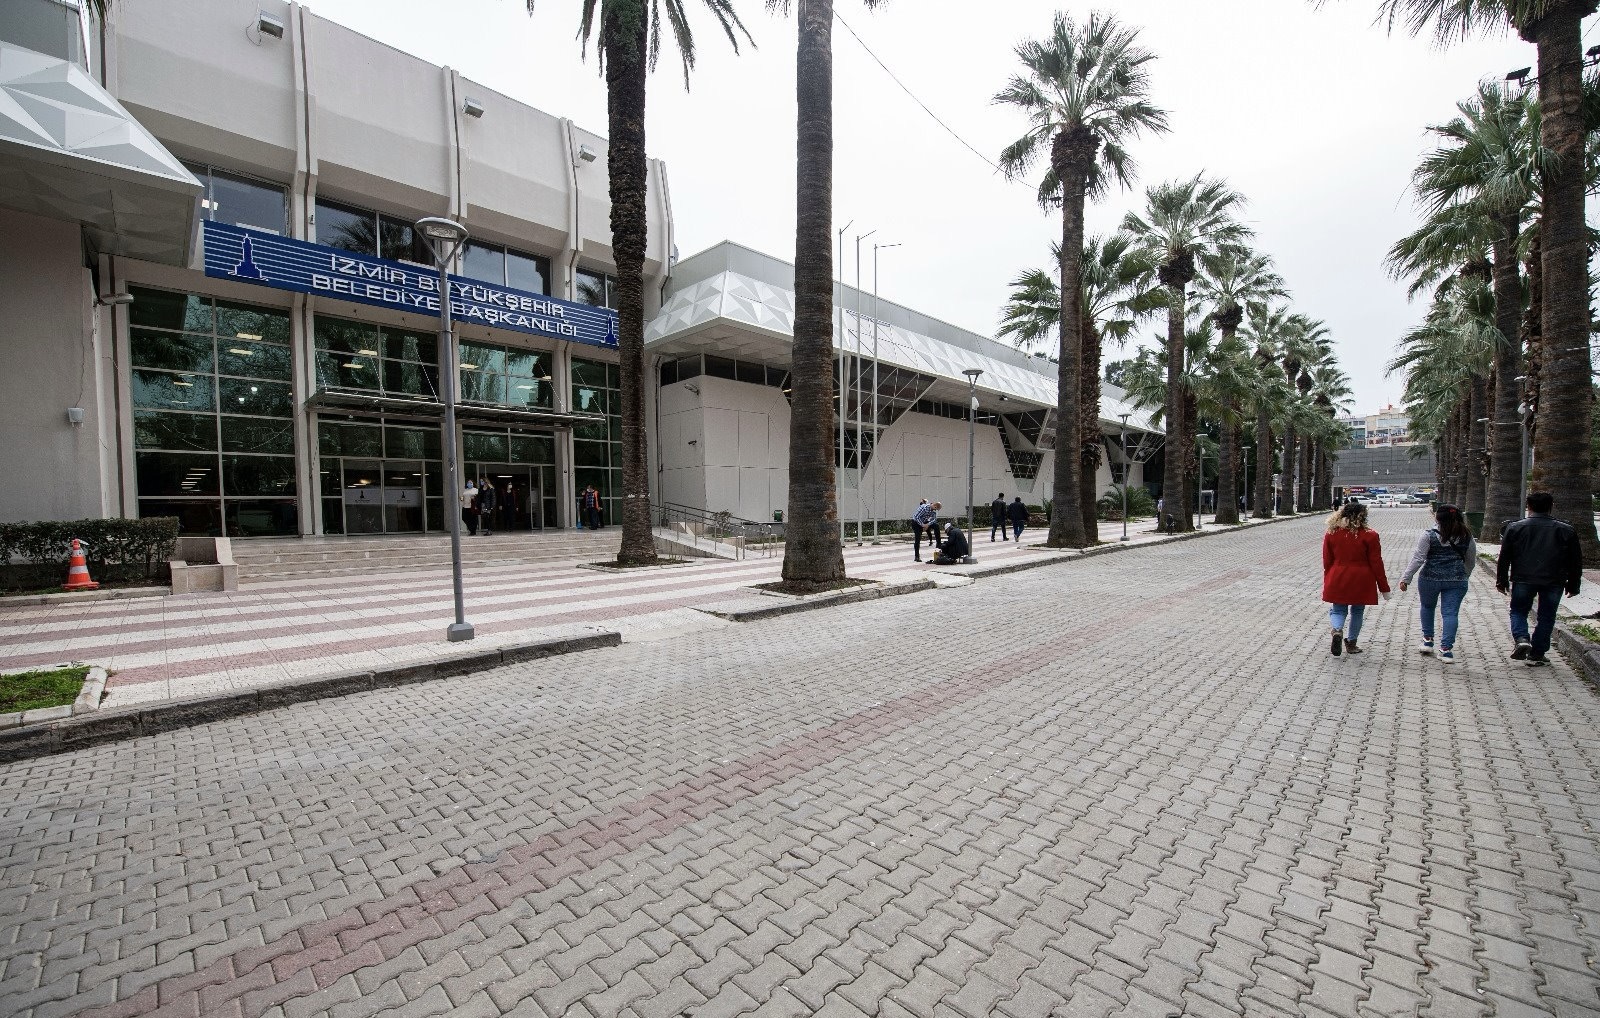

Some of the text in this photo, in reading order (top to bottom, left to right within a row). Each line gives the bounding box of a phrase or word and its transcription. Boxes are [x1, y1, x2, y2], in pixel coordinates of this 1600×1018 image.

[331, 253, 407, 285] İZMİR
[312, 273, 577, 337] BELEDİYE BAŞKANLIĞI
